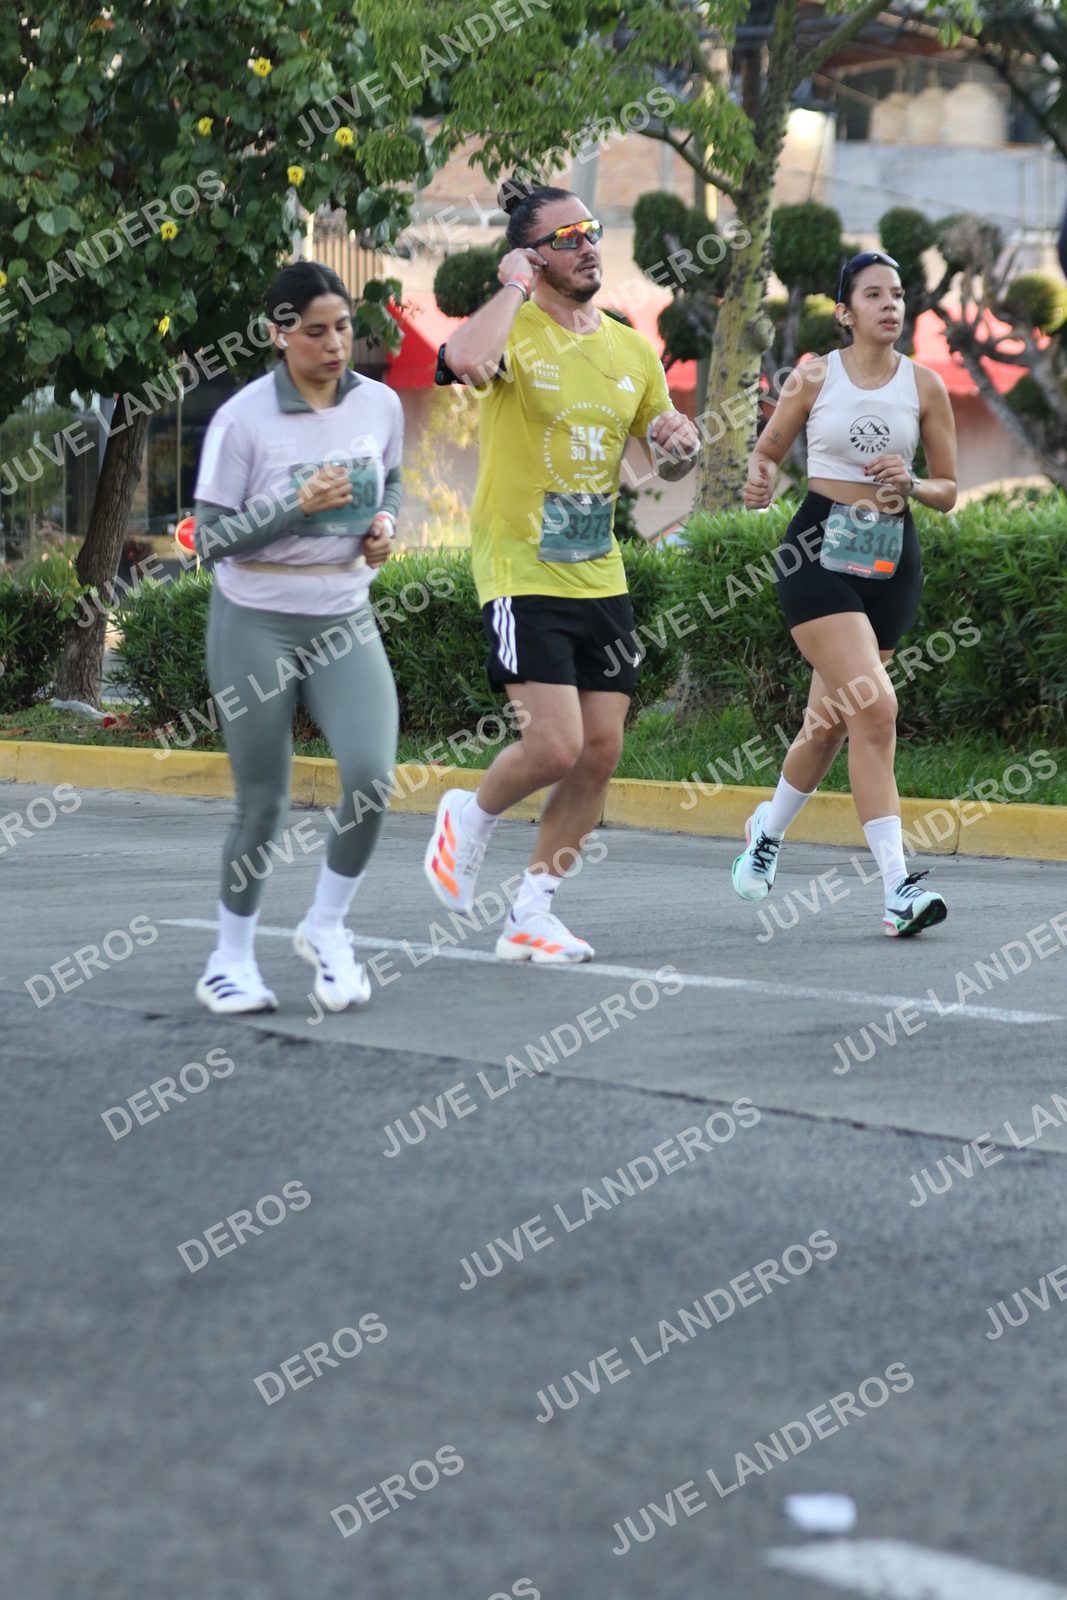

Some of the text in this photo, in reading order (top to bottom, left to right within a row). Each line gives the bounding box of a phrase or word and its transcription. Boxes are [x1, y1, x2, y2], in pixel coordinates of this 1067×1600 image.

[570, 426, 586, 440] 15
[588, 426, 608, 461] K
[850, 436, 890, 454] MANIACOS
[570, 446, 586, 460] 30
